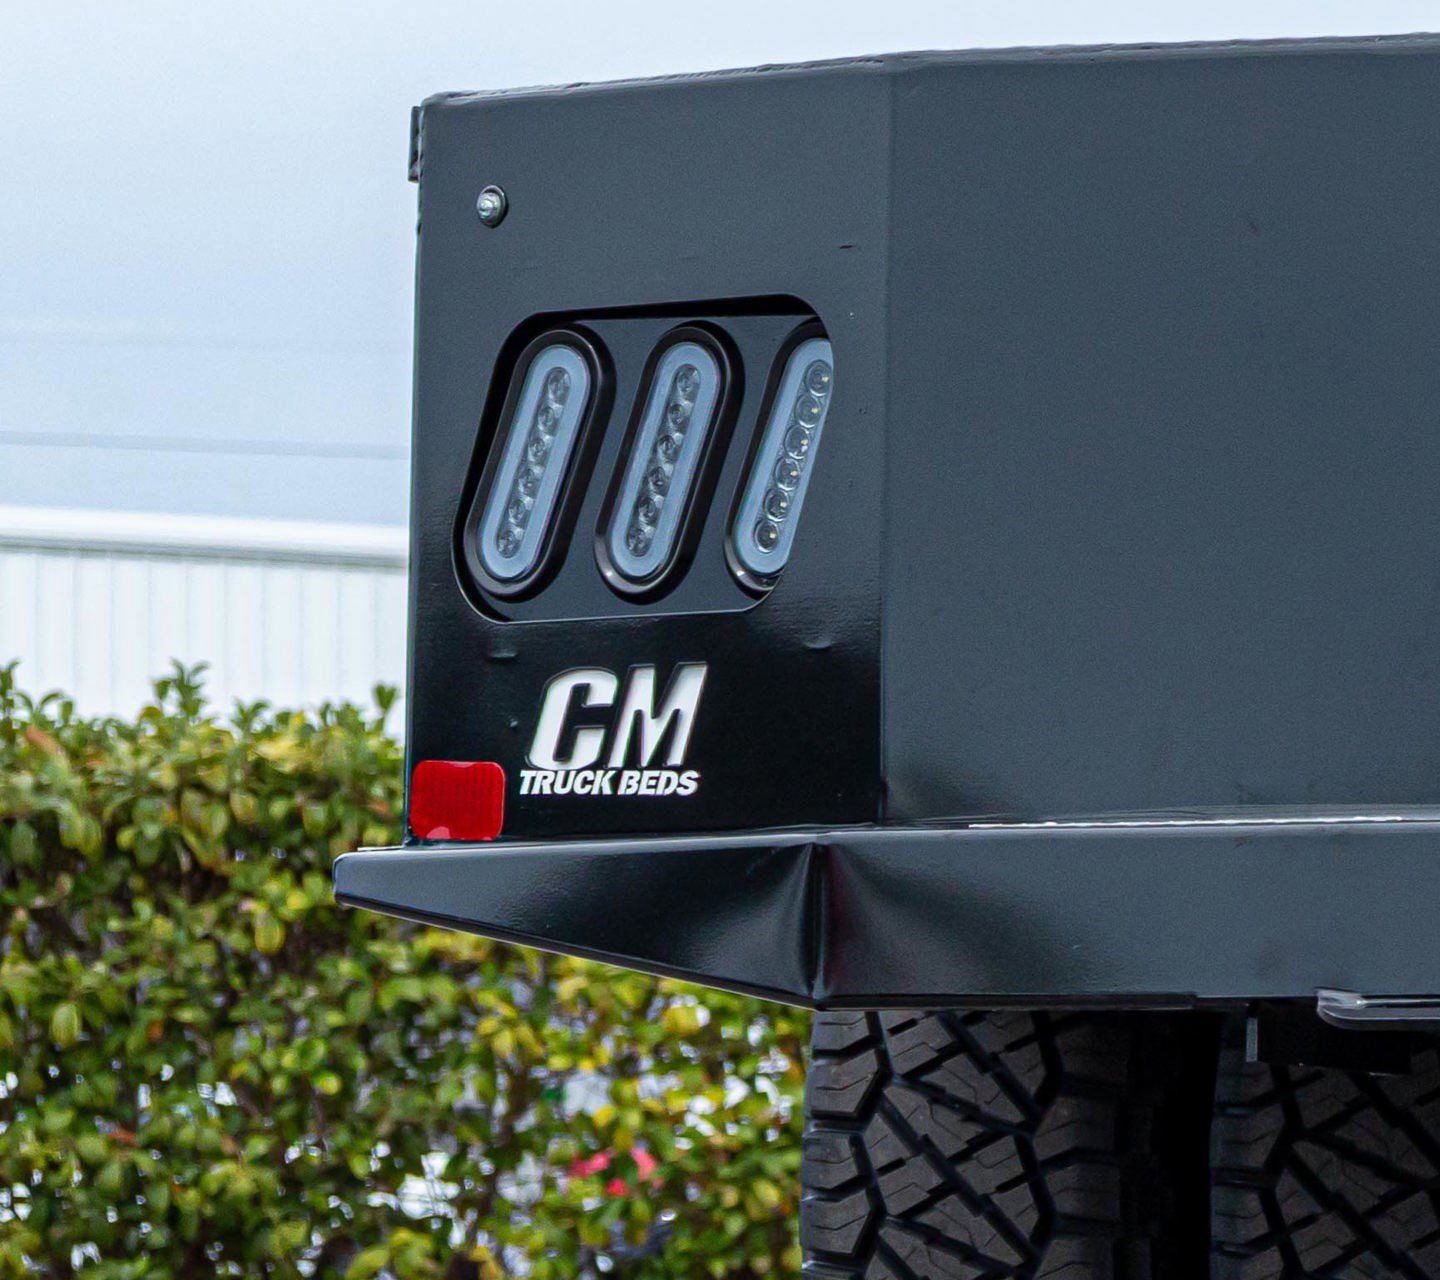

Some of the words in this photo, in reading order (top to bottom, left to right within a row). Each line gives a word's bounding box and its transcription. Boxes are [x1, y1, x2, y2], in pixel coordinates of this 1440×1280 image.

[527, 663, 708, 770] CM
[519, 770, 618, 795] TRUCK
[617, 770, 702, 796] BEDS
